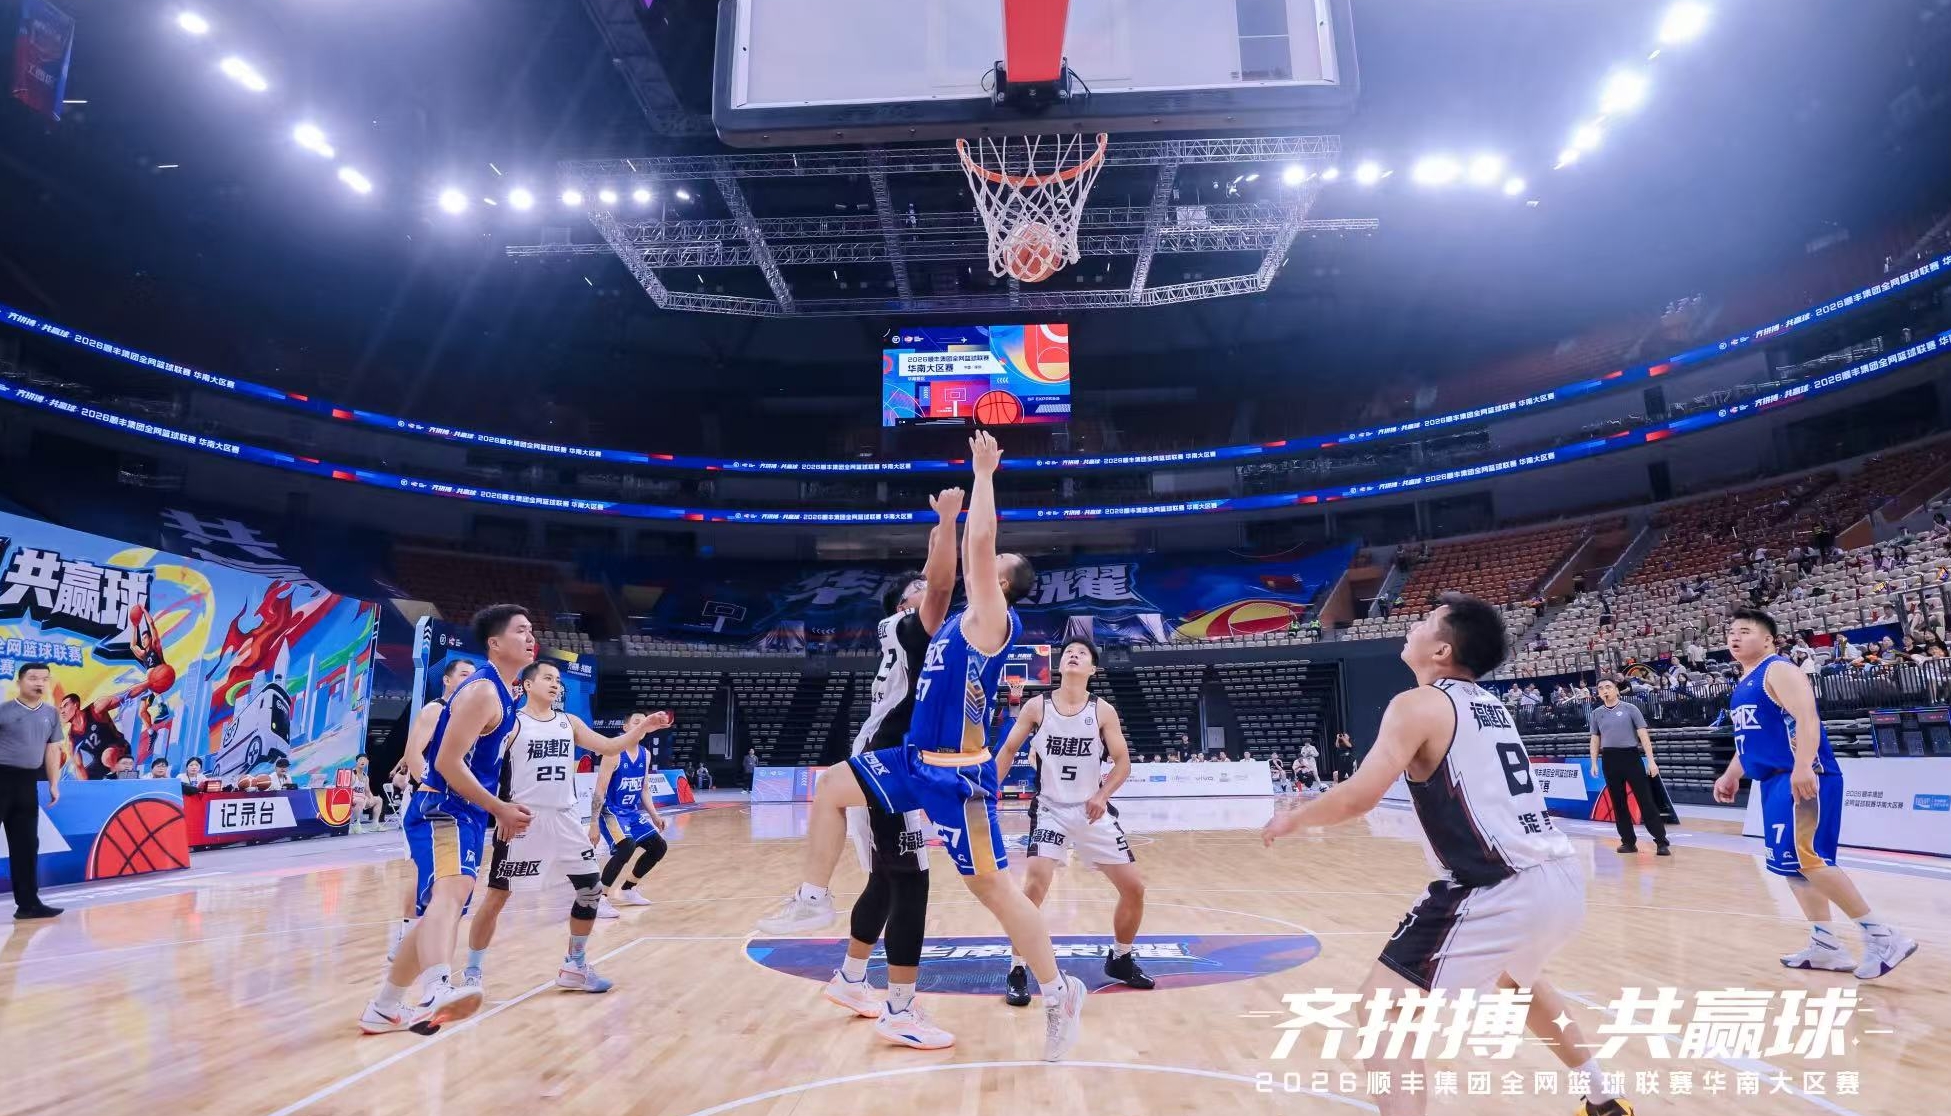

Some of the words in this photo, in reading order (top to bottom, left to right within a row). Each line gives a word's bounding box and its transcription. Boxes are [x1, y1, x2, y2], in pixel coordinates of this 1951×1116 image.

[1938, 334, 1951, 347] 华
[907, 362, 955, 373] 华南大区赛
[199, 437, 240, 454] 华南大区赛
[1469, 702, 1513, 731] 福建区
[526, 737, 571, 763] 福建区
[1045, 735, 1095, 757] 福建区
[536, 765, 566, 782] 25
[1060, 765, 1078, 781] 5
[1496, 742, 1535, 796] 8
[622, 794, 636, 805] 27
[221, 802, 274, 827] 记录台
[1031, 828, 1067, 847] 福建区
[1771, 823, 1786, 844] 7
[1115, 837, 1129, 852] 5
[496, 859, 544, 880] 福建区
